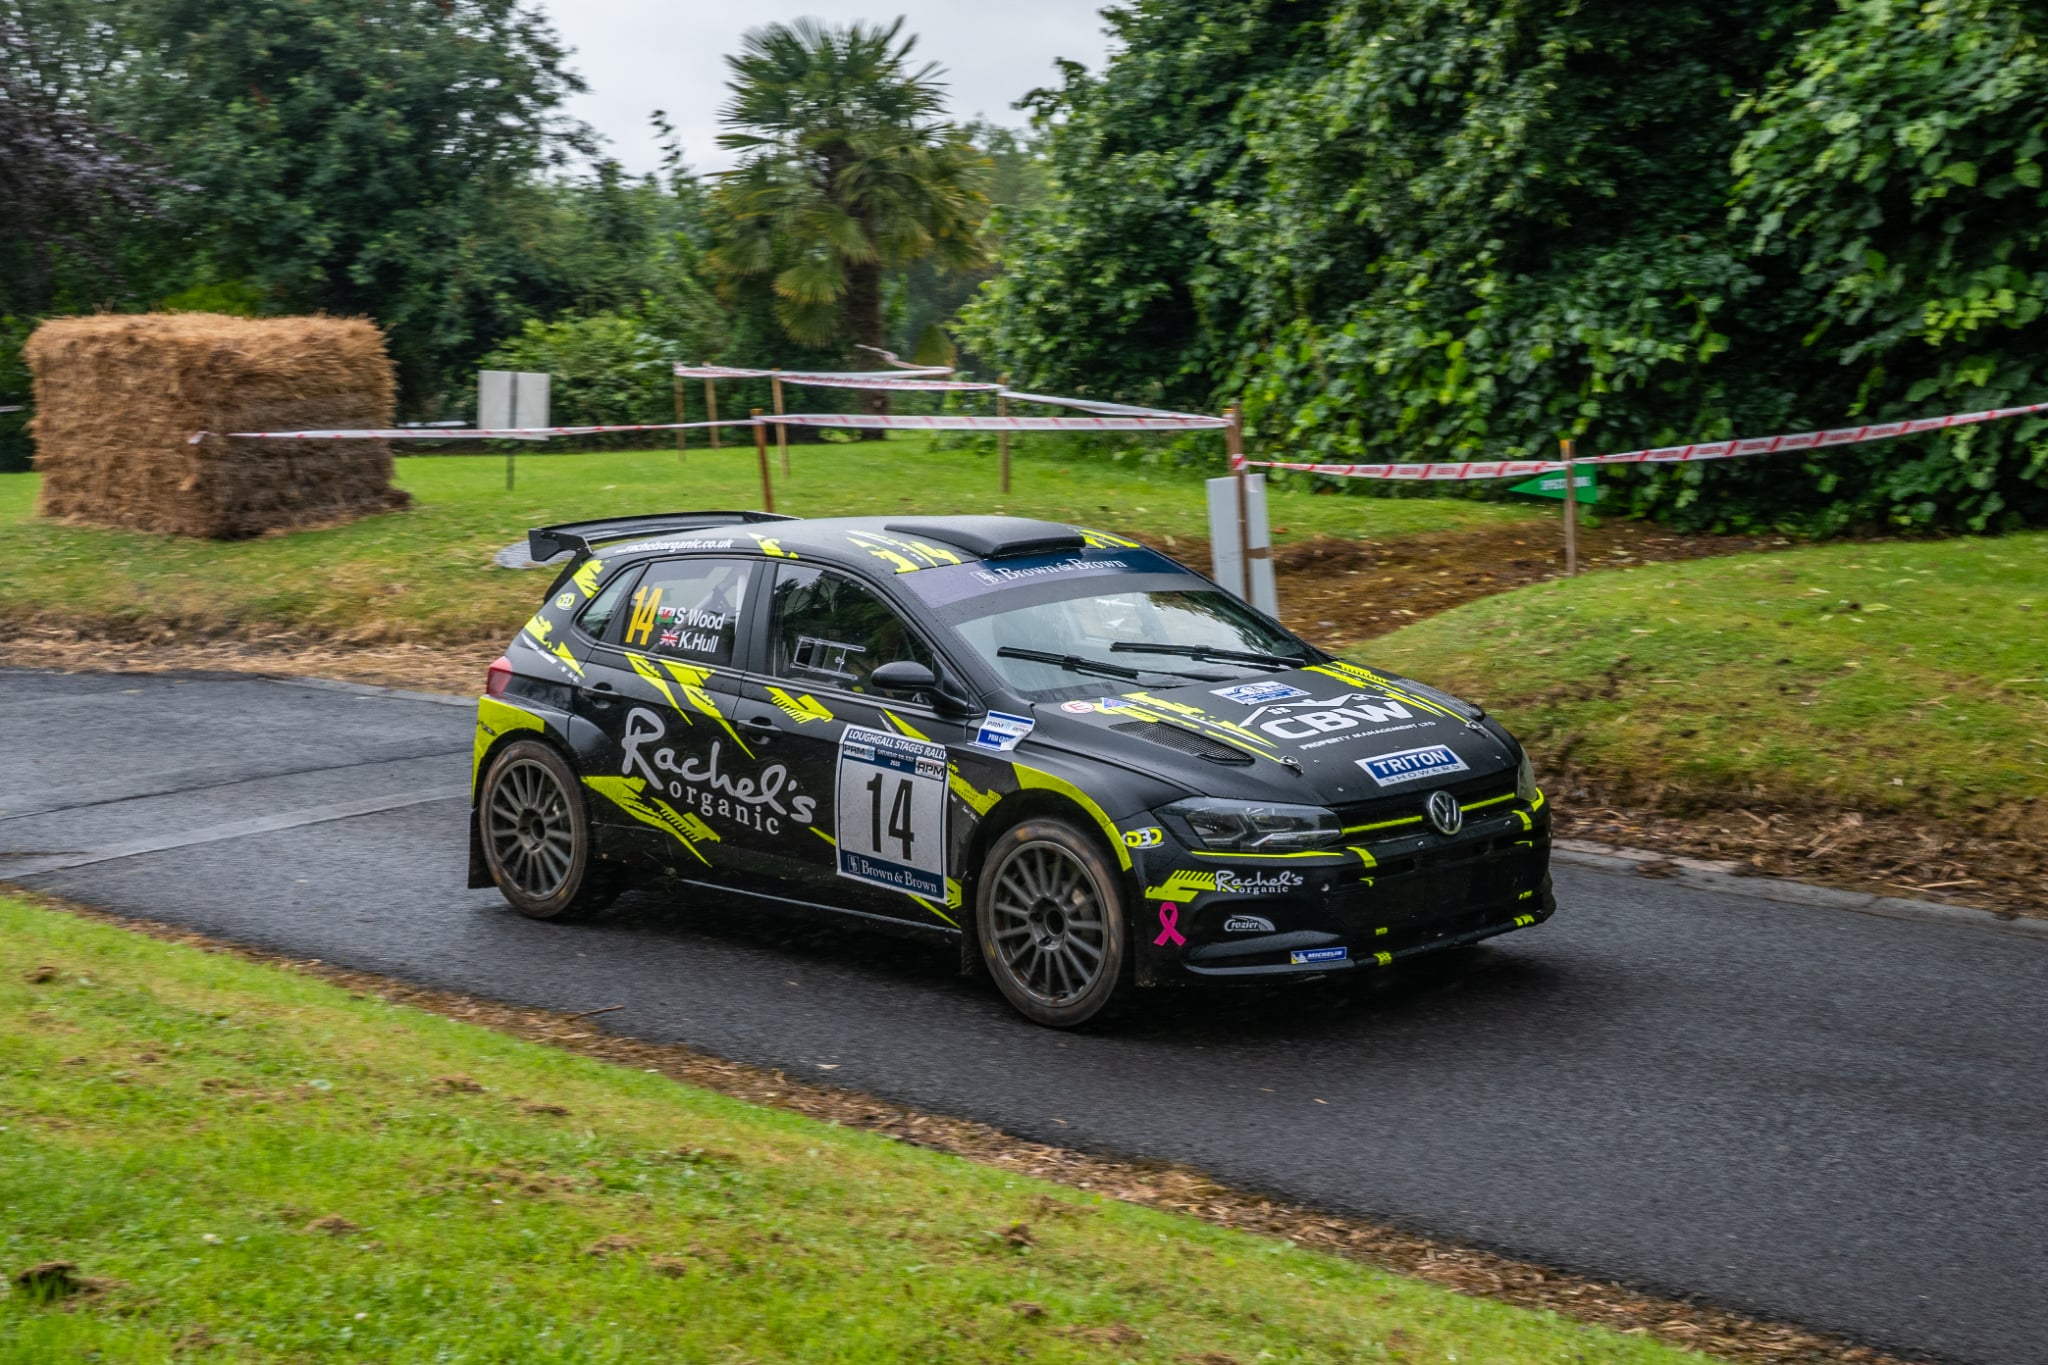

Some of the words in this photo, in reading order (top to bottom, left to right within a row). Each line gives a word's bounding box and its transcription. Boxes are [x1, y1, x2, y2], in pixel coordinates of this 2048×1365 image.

[999, 566, 1056, 580] Brown
[1055, 562, 1072, 572] &
[1064, 558, 1128, 571] Brown
[625, 586, 663, 646] 14
[674, 607, 687, 625] S
[687, 609, 726, 630] Wood
[678, 631, 719, 653] K.Hull
[1259, 701, 1414, 739] CBW
[848, 729, 894, 748] LOUGHGALL
[894, 741, 923, 756] STAGES
[924, 748, 947, 760] RALLY
[1299, 735, 1350, 750] PROPERTY
[1351, 723, 1417, 739] MANAGEMENT
[844, 745, 866, 756] PRM
[1373, 750, 1450, 775] TRITON
[621, 707, 817, 823] Rachel's
[917, 761, 944, 777] RPM
[1386, 764, 1460, 783] SHOWERS
[668, 781, 780, 835] organic
[867, 773, 914, 861] 14
[862, 860, 893, 881] Brown
[895, 874, 904, 882] &
[905, 871, 937, 893] Brown
[1215, 870, 1303, 892] Rachel's
[1239, 885, 1289, 895] organic
[1224, 919, 1258, 932] Crozier
